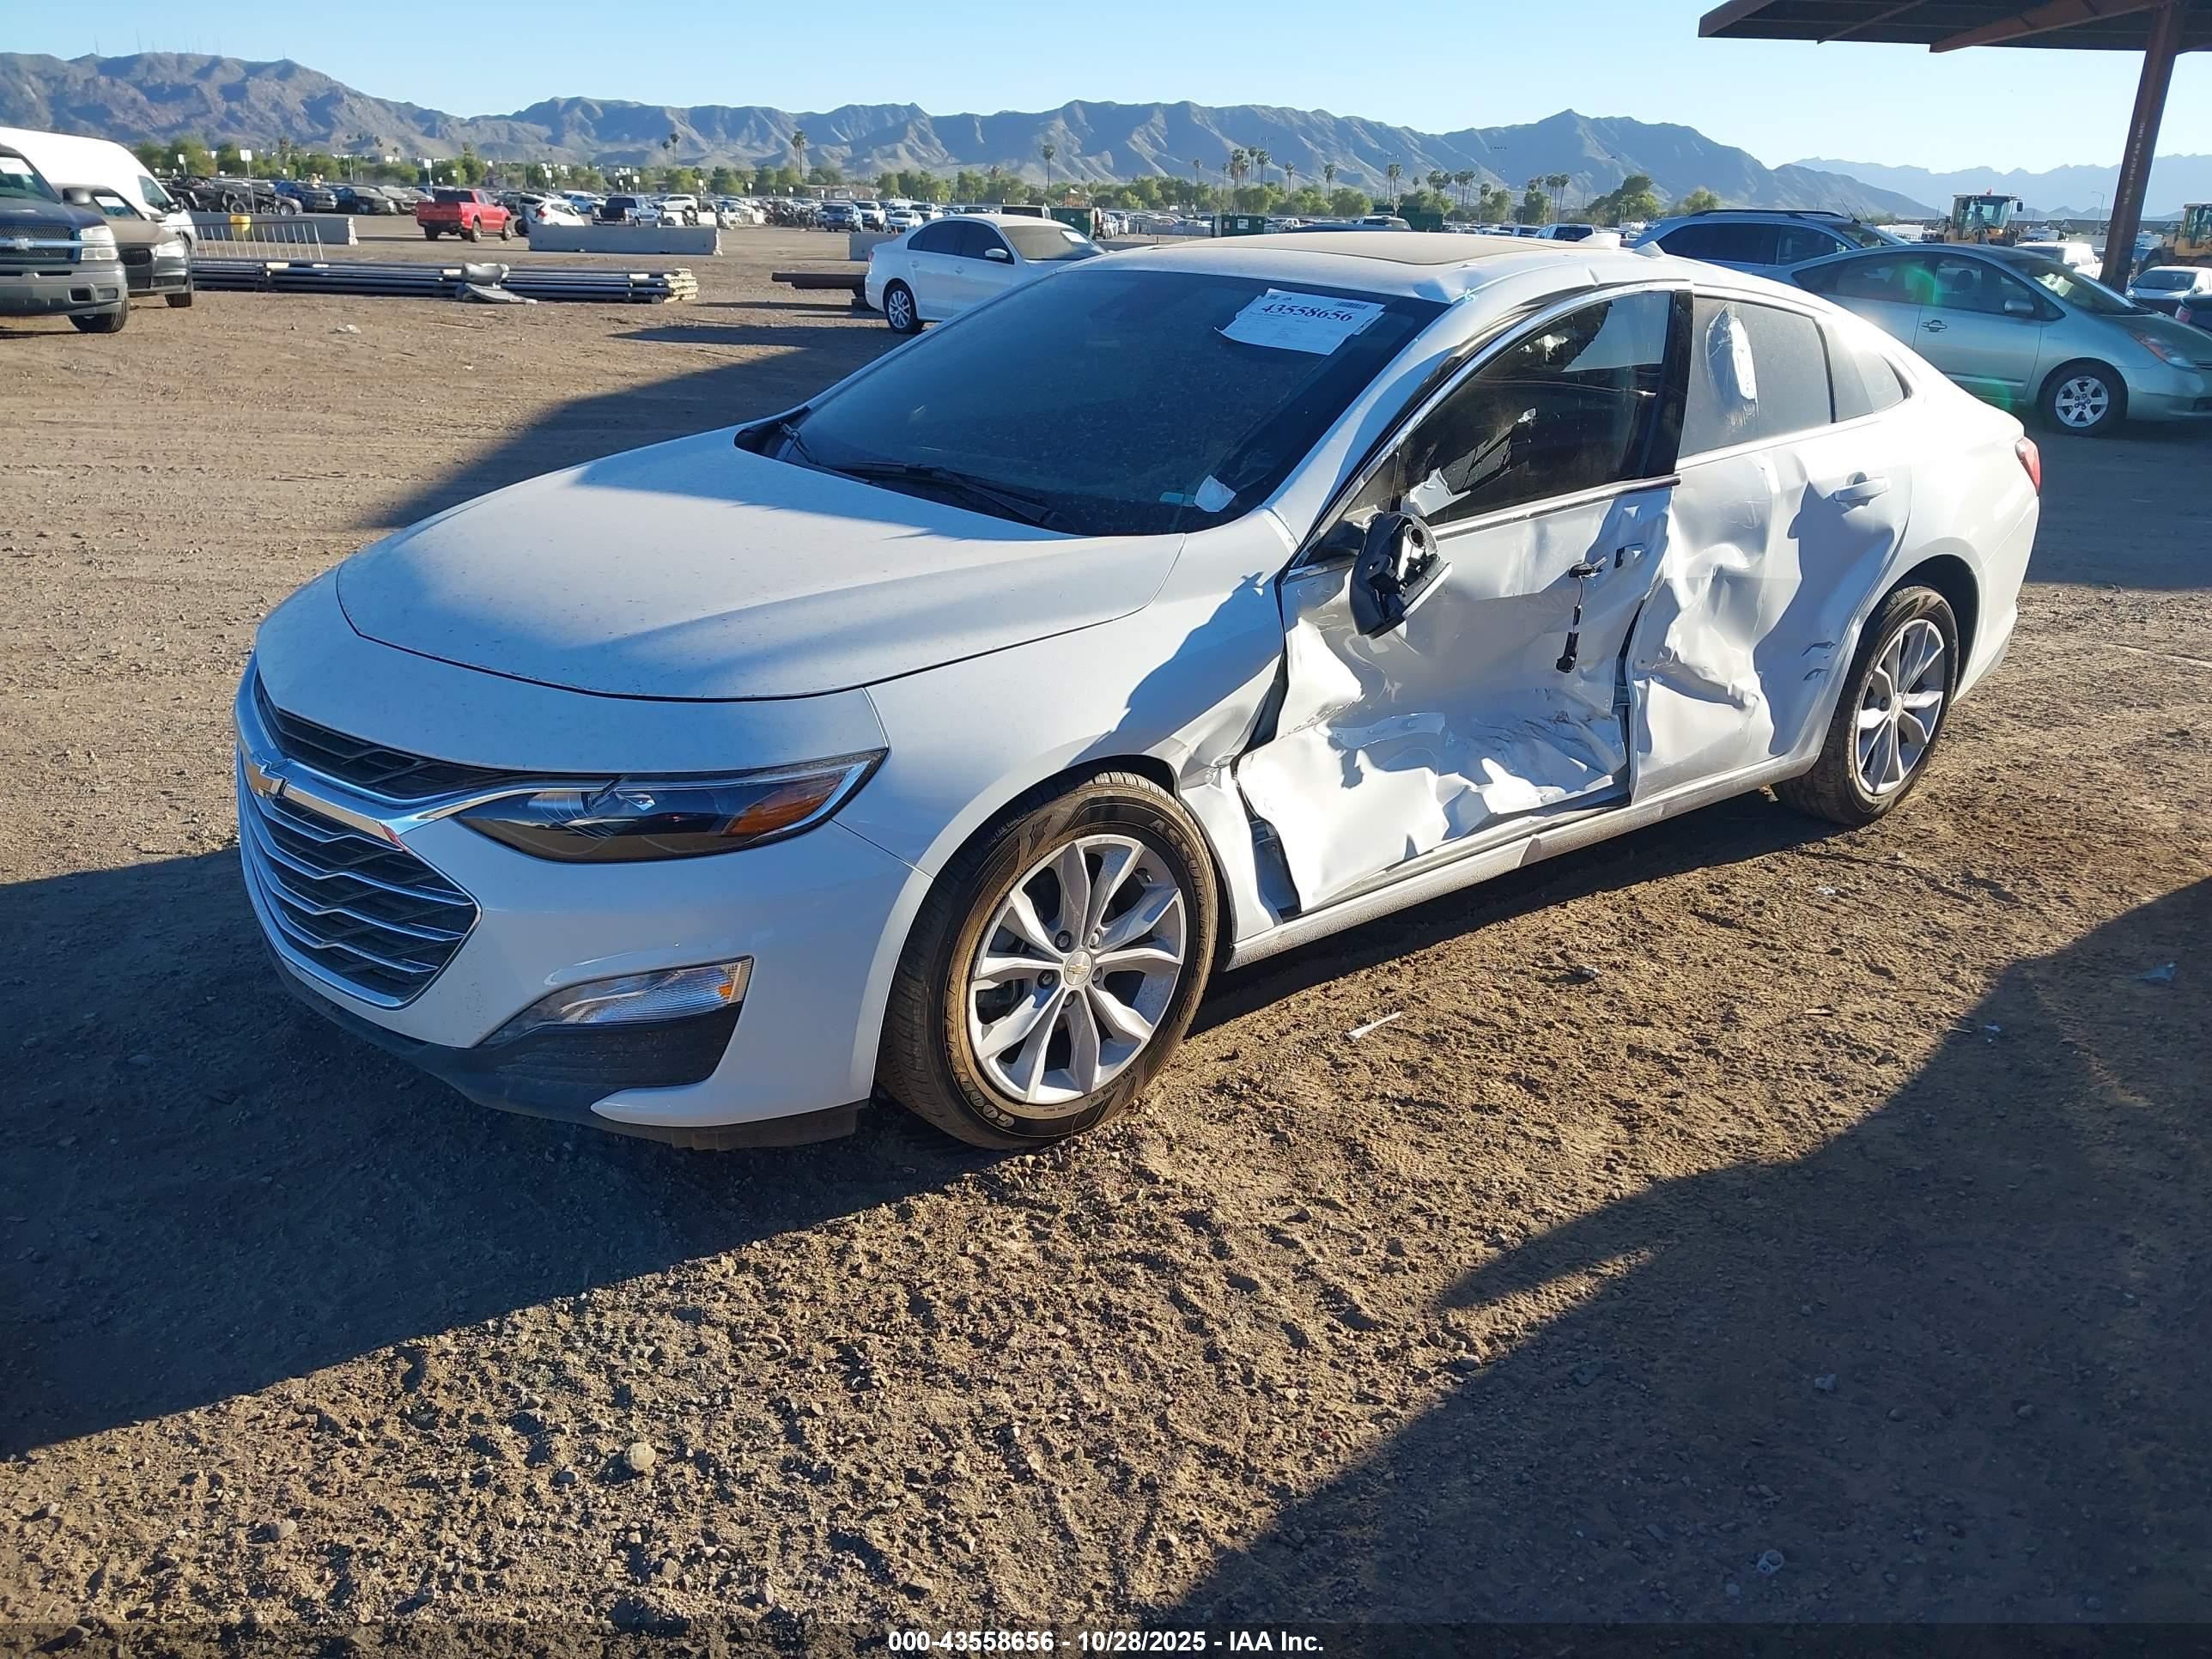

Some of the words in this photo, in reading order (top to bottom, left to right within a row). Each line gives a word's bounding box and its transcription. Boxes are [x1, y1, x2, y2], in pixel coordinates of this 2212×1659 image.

[1261, 303, 1356, 322] 43558656
[1148, 819, 1207, 981] ASSURANCE
[945, 971, 1015, 1128] GOODYEAR
